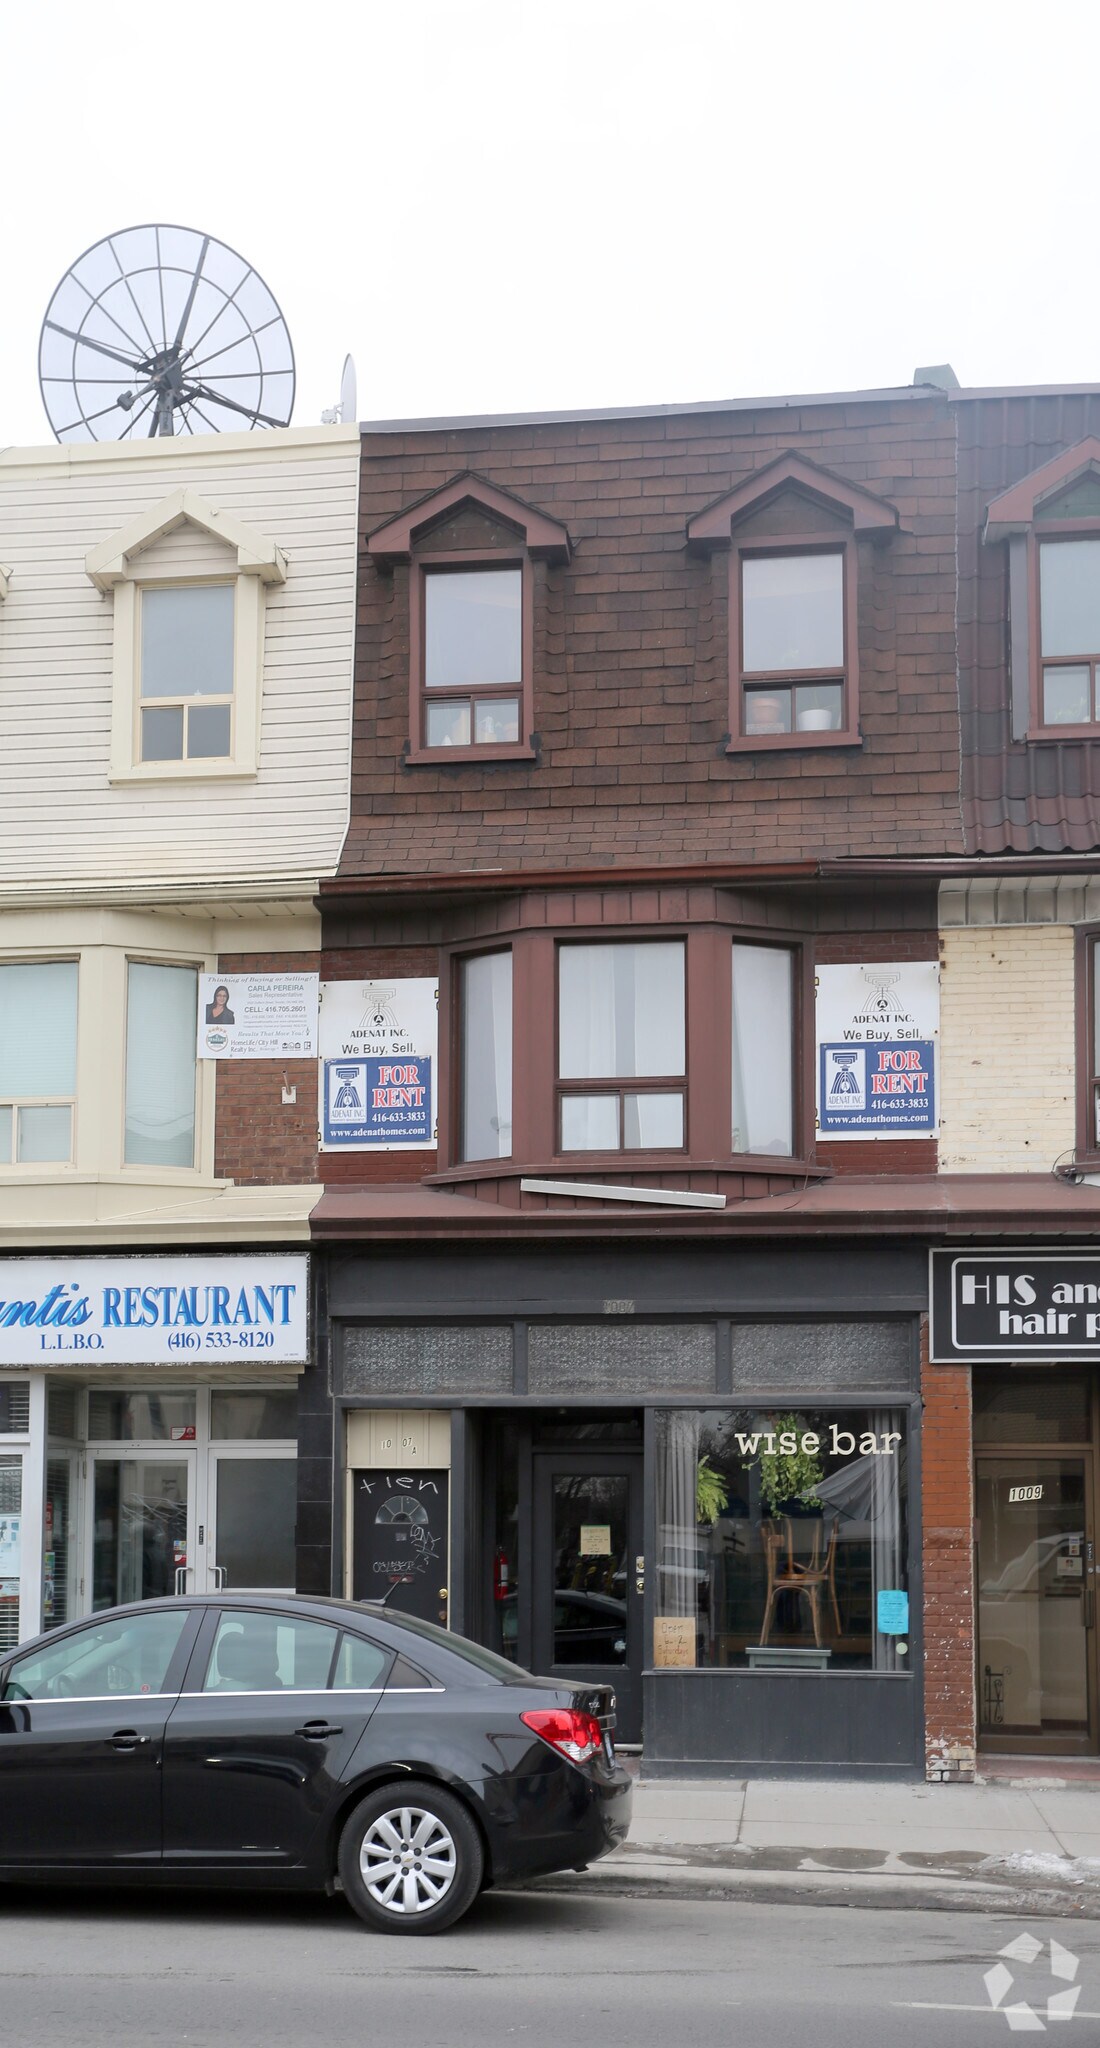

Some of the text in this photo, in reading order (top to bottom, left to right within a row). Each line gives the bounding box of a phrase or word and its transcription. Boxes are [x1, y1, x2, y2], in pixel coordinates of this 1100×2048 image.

[852, 1014, 915, 1024] ADENAT INC.
[350, 1028, 409, 1038] ADENAT INC.
[843, 1028, 923, 1042] We Buy, Sell,
[342, 1042, 417, 1056] We Buy, Sell,
[877, 1050, 922, 1071] FOR
[378, 1064, 420, 1086] FOR
[871, 1072, 929, 1094] RENT
[371, 1086, 426, 1108] RENT
[871, 1098, 929, 1109] 416-633-3833
[371, 1111, 426, 1123] 416-633-3833
[827, 1113, 929, 1124] www.adenathomes.com
[330, 1127, 426, 1137] www.adenathomes.com
[962, 1274, 1037, 1306] HIS
[101, 1284, 297, 1328] RESTAURANT
[1000, 1308, 1077, 1335] hair
[40, 1331, 275, 1352] L.L.B.O. (416) 533-8120
[734, 1423, 902, 1456] wise bar
[1011, 1486, 1042, 1501] 1009
